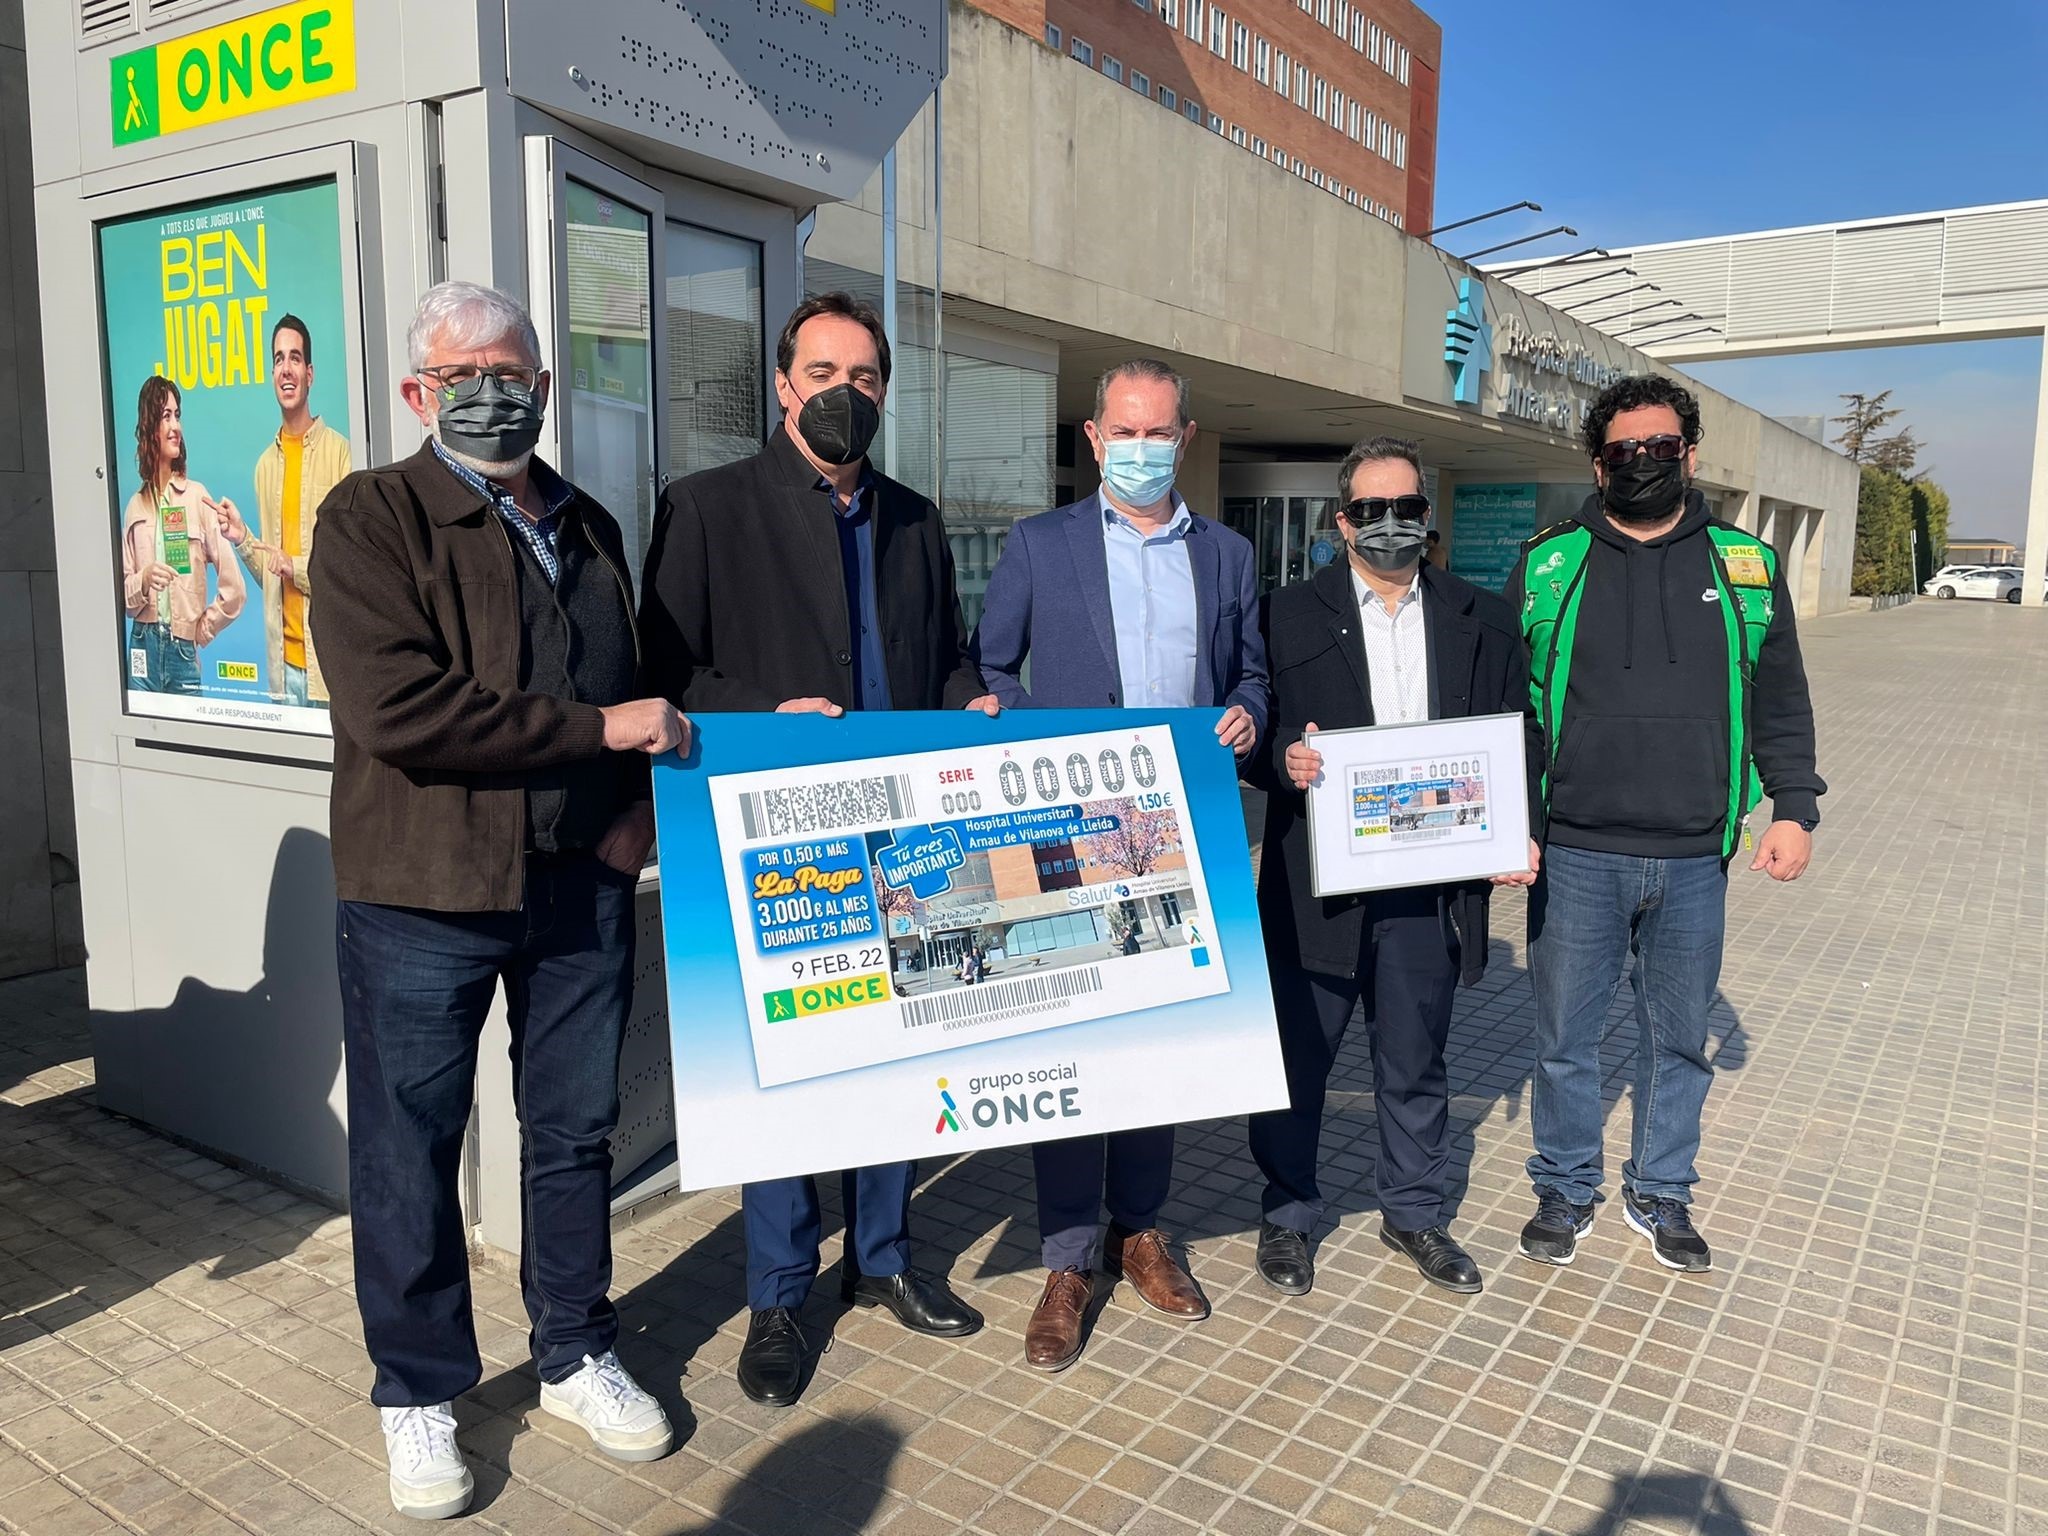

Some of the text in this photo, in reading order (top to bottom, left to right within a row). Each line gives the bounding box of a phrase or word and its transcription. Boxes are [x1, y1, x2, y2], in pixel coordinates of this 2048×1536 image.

[177, 9, 333, 112] ONCE
[161, 206, 265, 236] A TOTS ELS QUE JUGUEU A L'ONCE
[161, 223, 267, 302] BEN
[154, 295, 268, 390] JUGAT
[1500, 312, 1569, 375] Hospital
[1730, 547, 1761, 557] ONCE
[228, 665, 255, 678] ONCE
[208, 707, 223, 716] JUGA
[225, 708, 282, 721] RESPONSABLEMENT
[1004, 750, 1011, 758] R
[1146, 754, 1155, 776] ONCE
[938, 768, 975, 784] SERIE
[1049, 767, 1059, 789] ONCE
[1068, 765, 1077, 787] ONCE
[1082, 763, 1092, 785] ONCE
[1100, 761, 1110, 783] ONCE
[1114, 759, 1123, 781] ONCE
[1132, 756, 1141, 778] ONCE
[1001, 773, 1010, 796] ONCE
[1016, 771, 1025, 793] ONCE
[1034, 769, 1044, 791] ONCE
[941, 789, 982, 815] 000
[965, 806, 1074, 832] Hospital Universitari
[1364, 826, 1388, 834] ONCE
[969, 818, 1114, 848] Arnau de Vilanova de Lleida
[758, 841, 849, 867] POR 0,50 € MÁS
[892, 838, 943, 863] Tú eres
[888, 848, 960, 883] IMPORTANTE
[753, 865, 863, 899] La Paga
[757, 896, 813, 927] 3.000
[826, 900, 841, 915] AL
[843, 895, 869, 912] MES
[762, 915, 872, 948] DURANTE 25 AÑOS
[791, 947, 884, 979] 9 FEB. 22
[801, 977, 883, 1011] ONCE
[969, 1062, 1077, 1094] grupo social
[972, 1086, 1082, 1128] ONCE
